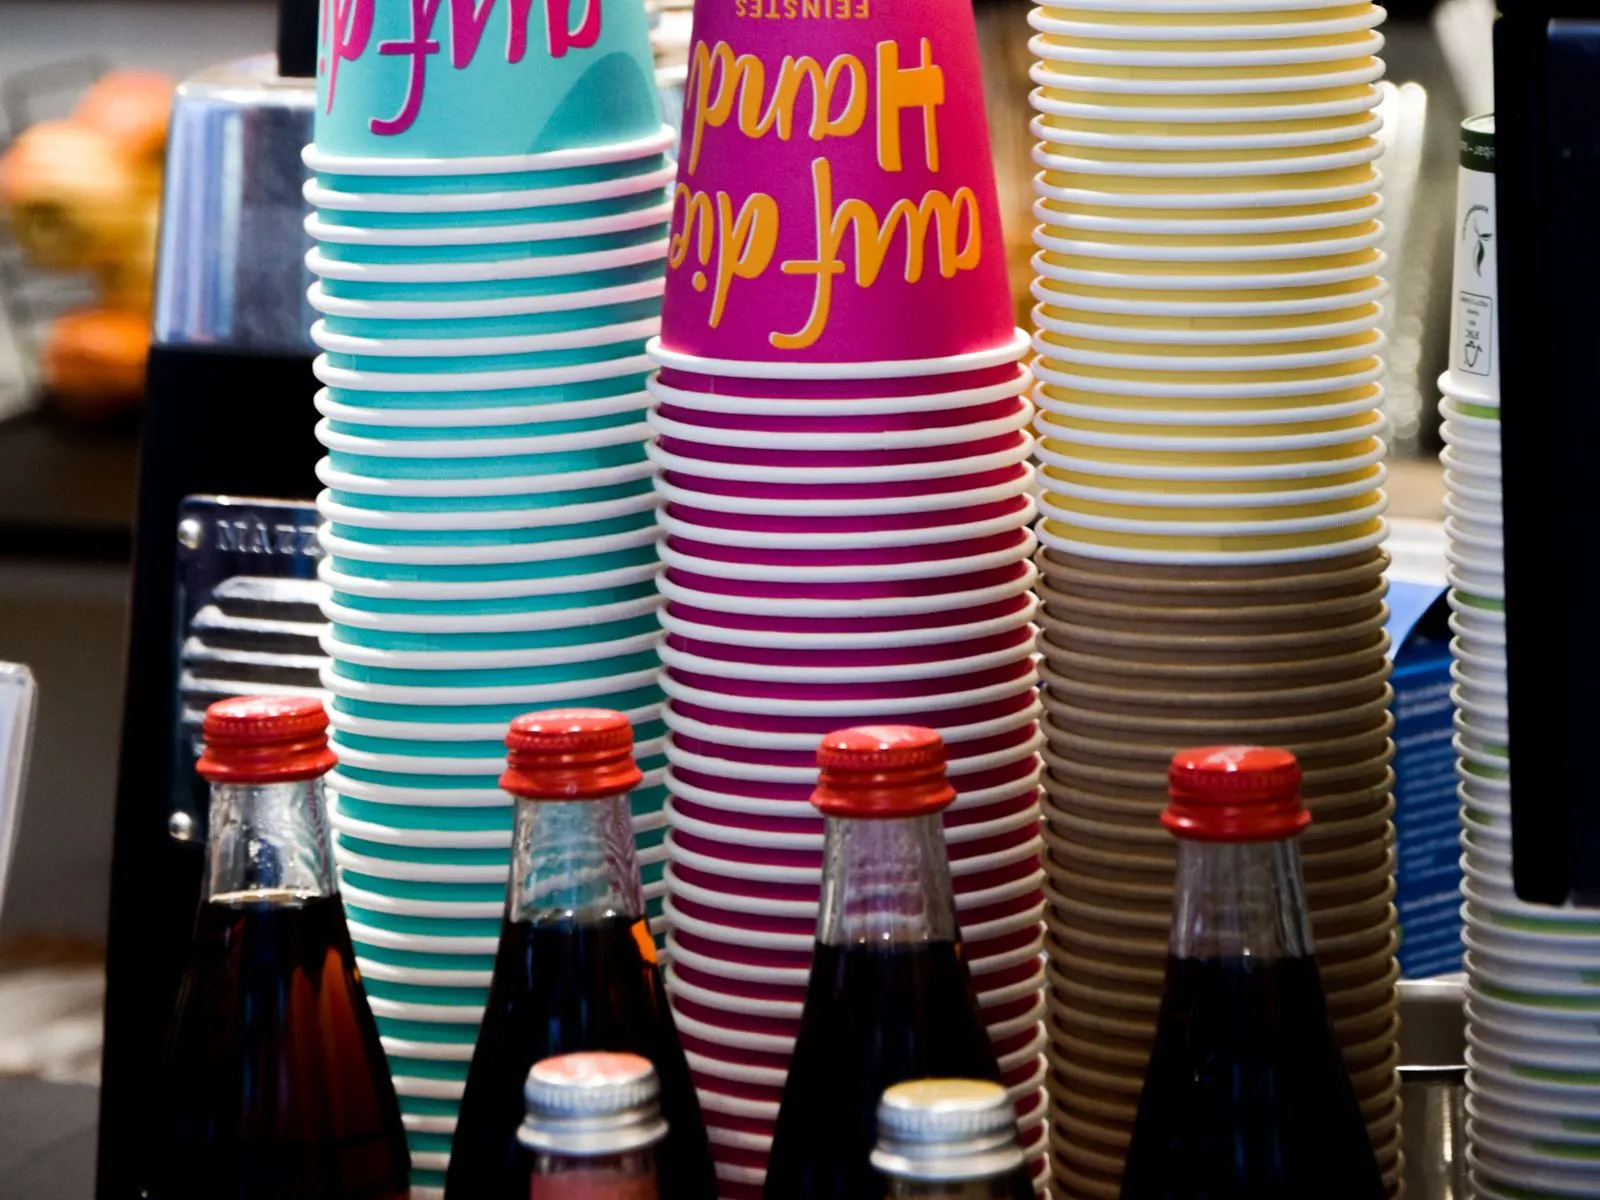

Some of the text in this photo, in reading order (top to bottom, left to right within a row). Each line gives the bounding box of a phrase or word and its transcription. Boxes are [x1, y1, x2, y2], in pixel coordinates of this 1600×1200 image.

[686, 37, 945, 177] Hand
[669, 157, 982, 349] auf die
